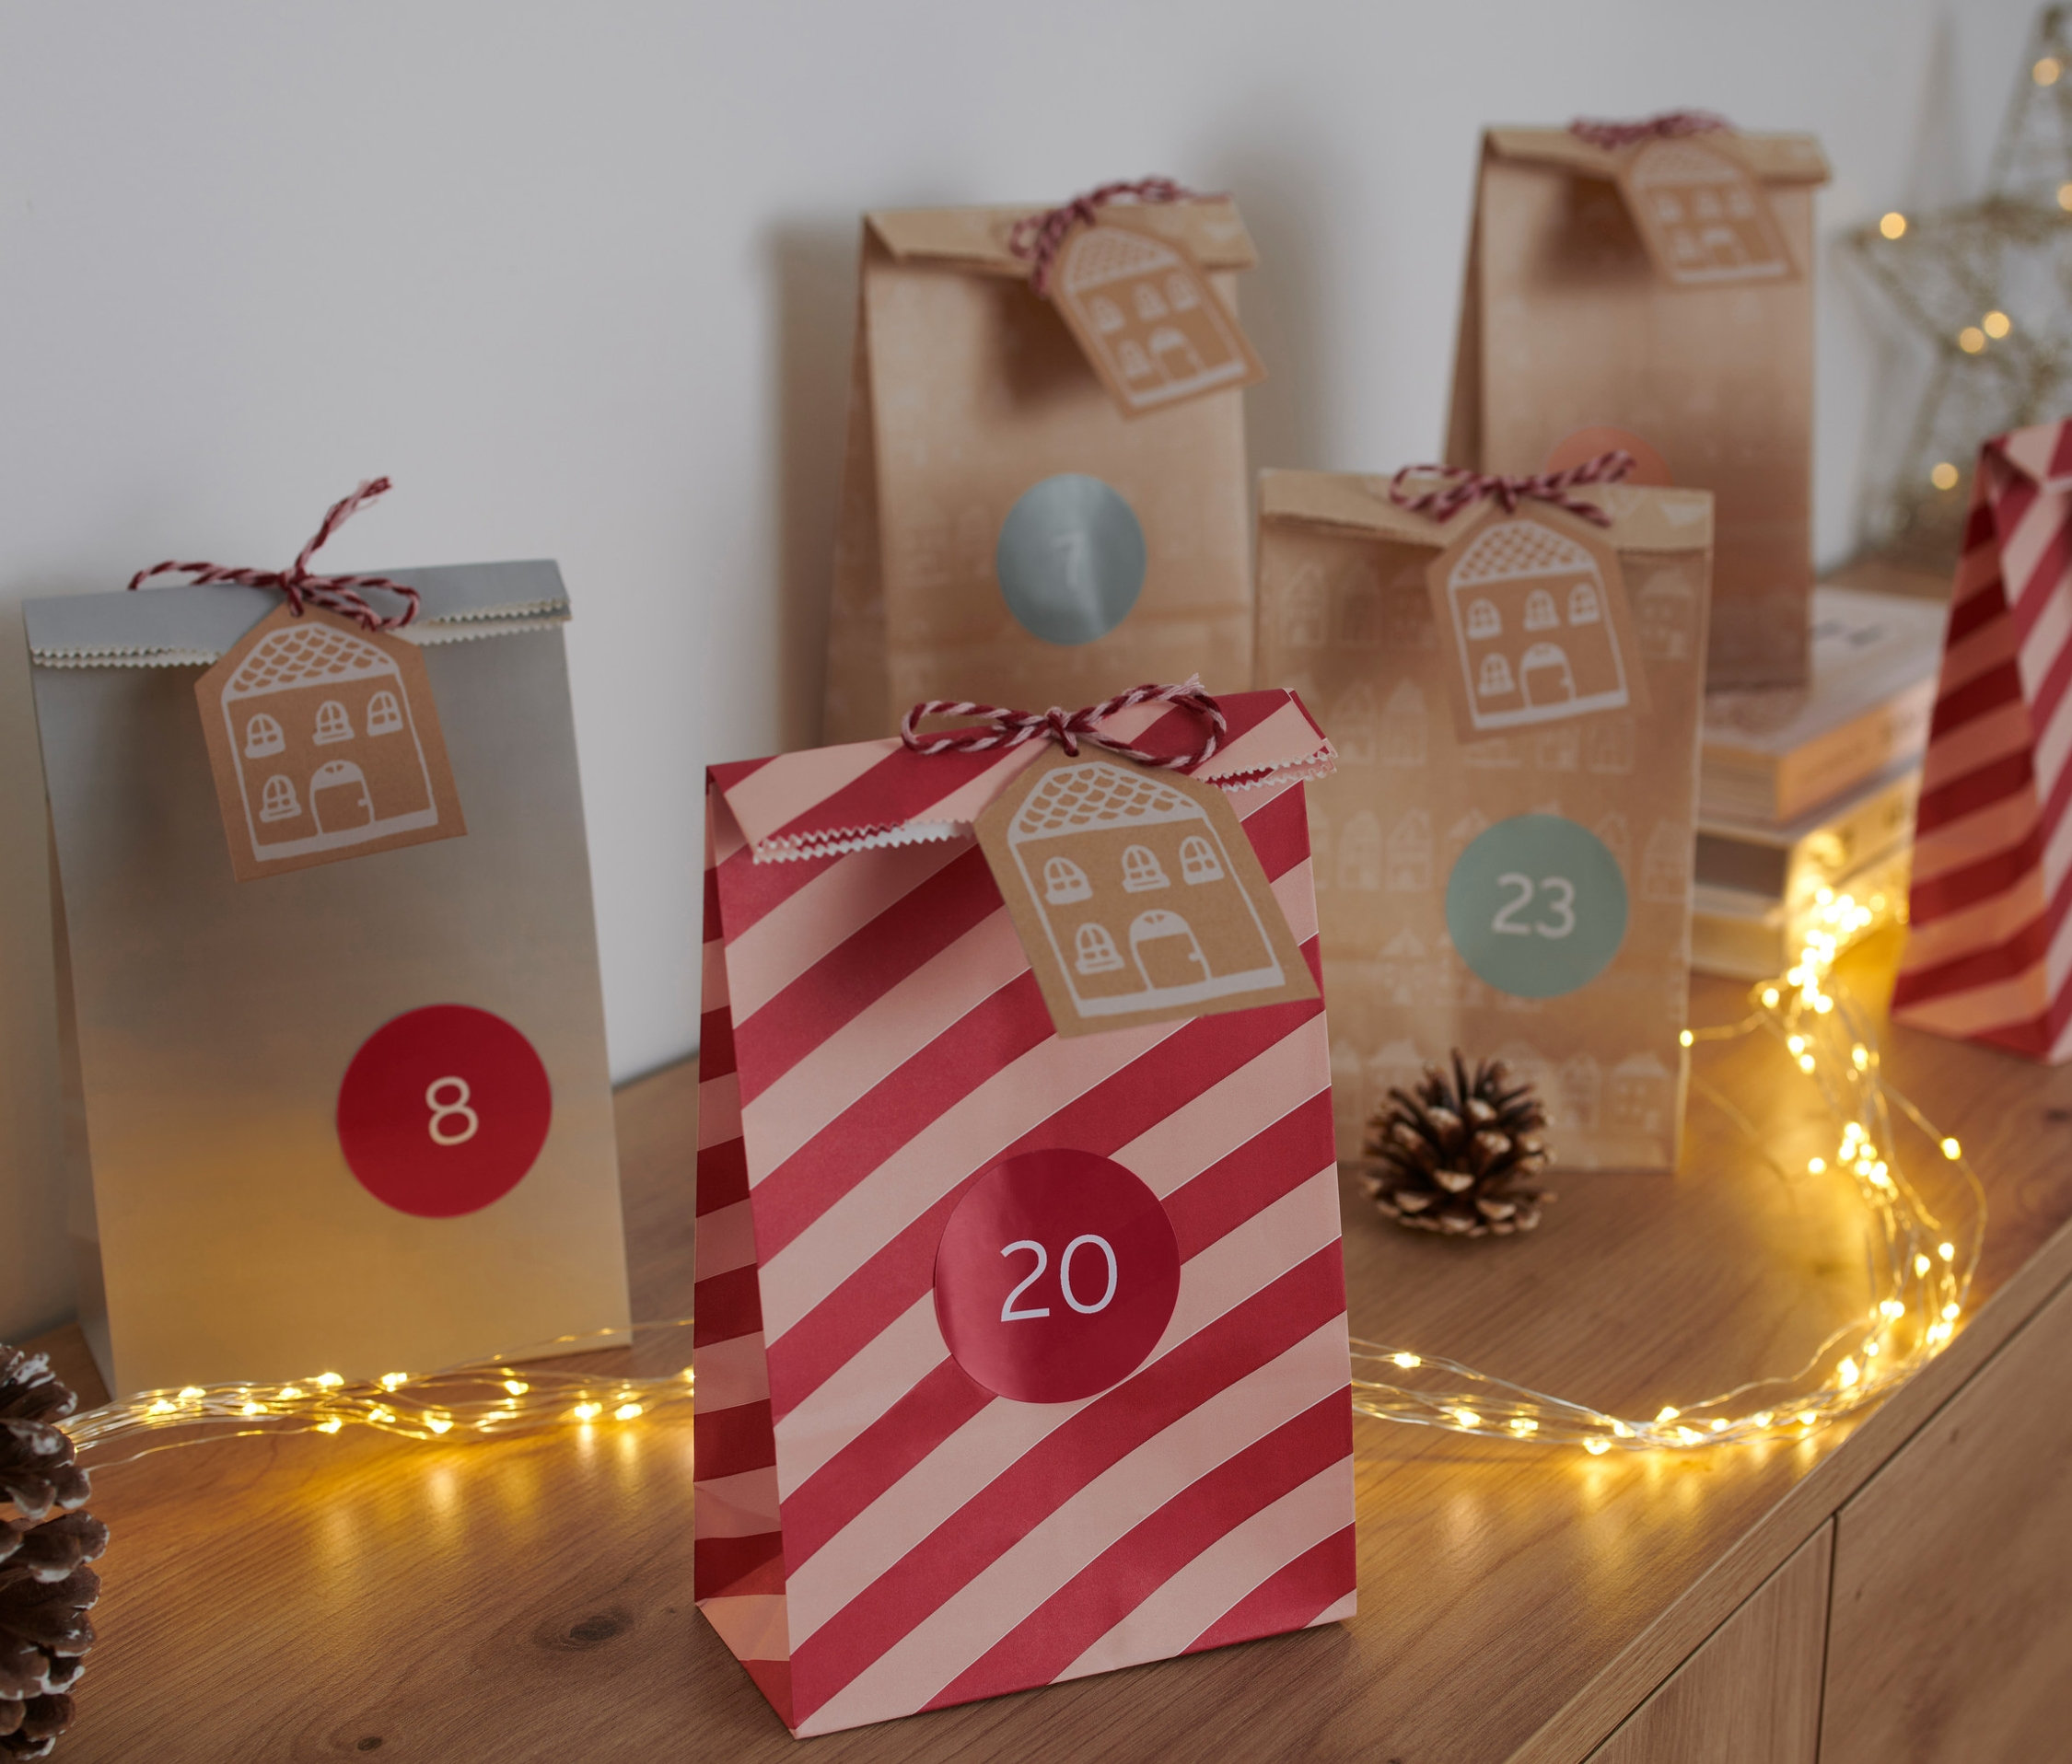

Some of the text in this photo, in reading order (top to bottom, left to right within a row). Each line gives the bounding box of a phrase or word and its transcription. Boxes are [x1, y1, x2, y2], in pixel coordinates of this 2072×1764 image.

[1050, 530, 1088, 587] 7
[1493, 873, 1576, 939] 23
[425, 1075, 479, 1146] 8
[1000, 1234, 1118, 1322] 20
